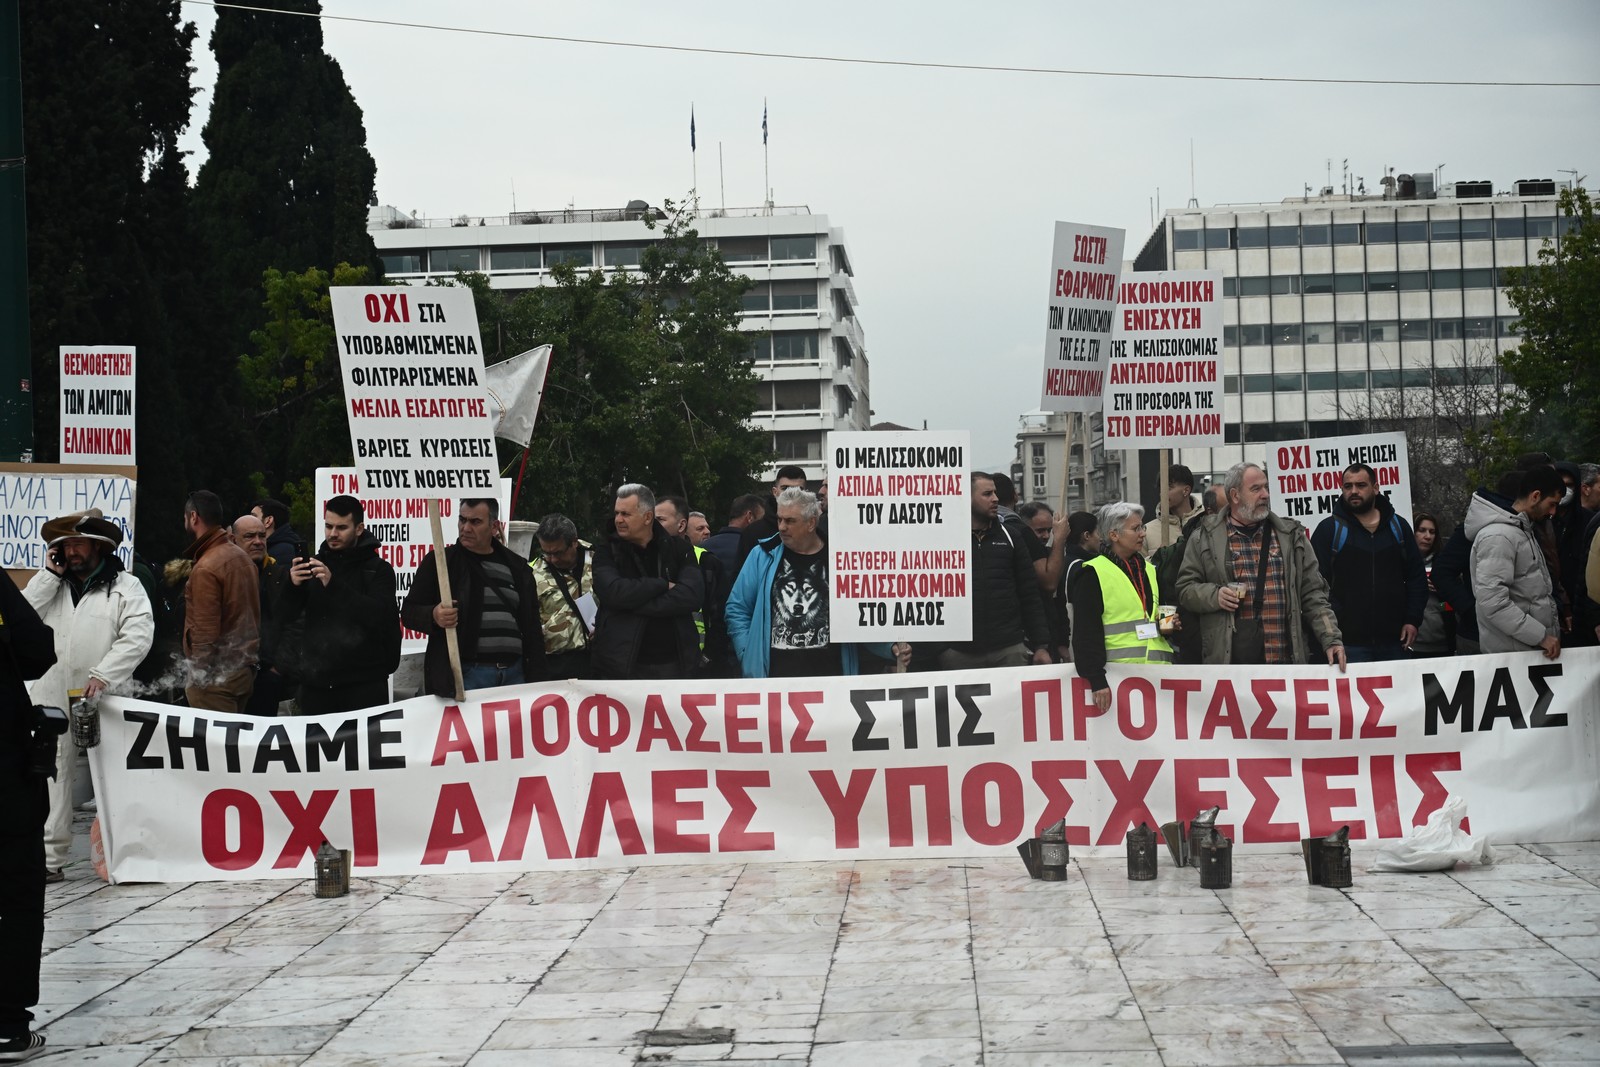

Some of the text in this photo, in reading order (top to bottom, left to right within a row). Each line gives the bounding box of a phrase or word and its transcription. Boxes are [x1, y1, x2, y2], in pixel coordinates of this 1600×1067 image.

[1073, 234, 1107, 264] ΣΩΣΤΗ
[1056, 269, 1116, 301] ΕΦΑΡΜΟΓΗ
[364, 294, 446, 323] ΟΧΙ ΣΤΑ
[1124, 308, 1201, 330] ΕΝΙΣΧΥΣΗ
[1050, 306, 1112, 334] ΤΩΝ ΚΑΝΟΝΙΣΜΩΝ
[342, 335, 478, 354] ΥΠΟΒΑΘΜΙΣΜΕΝΑ
[1060, 337, 1073, 360] ΤΗΣ
[1088, 339, 1100, 362] ΣΤΗ
[1134, 338, 1218, 357] ΜΕΛΙΣΣΟΚΟΜΙΑΣ
[64, 354, 131, 376] ΘΕΣΜΟΘΕΤΗΣΗ
[1110, 361, 1216, 384] ΑΝΤΑΠΟΔΟΤΙΚΗ
[352, 367, 478, 386] ΦΙΛΤΡΑΡΙΣΜΕΝΑ
[1046, 368, 1104, 396] ΜΕΛΙΣΣΟΚΟΜΙΑ
[64, 389, 132, 416] ΤΩΝ ΑΜΙΓΩΝ
[352, 398, 487, 418] ΜΕΛΙΑ ΕΙΣΑΓΩΓΗΣ
[1114, 391, 1214, 410] ΣΤΗ ΠΡΟΣΦΟΡΑ ΤΗΣ
[1107, 414, 1220, 437] ΣΤΟ ΠΕΡΙΒΑΛΛΟΝ
[64, 427, 132, 455] ΕΛΛΗΝΙΚΩΝ
[357, 438, 493, 458] ΒΑΡΙΕΣ ΚΥΡΩΣΕΙΣ
[836, 446, 962, 468] ΟΙ ΜΕΛΙΣΣΟΚΟΜΟΙ
[1278, 444, 1396, 470] ΟΧΙ ΣΤΗ ΜΕΙΩΣΗ
[332, 474, 344, 494] ΤΟ
[366, 470, 410, 488] ΣΤΟΥΣ
[414, 470, 492, 488] ΝΟΘΕΥΤΕΣ
[838, 474, 962, 496] ΑΣΠΙΔΑ ΠΡΟΣΤΑΣΙΑΣ
[1278, 474, 1308, 494] ΤΩΝ
[406, 498, 451, 518] ΜΗΤΩΟ
[857, 502, 942, 524] ΤΟΥ ΔΑΣΟΥΣ
[1285, 496, 1313, 516] ΤΗΣ
[836, 550, 966, 570] ΕΛΕΥΘΕΡΗ ΔΙΑΚΙΝΗΣΗ
[836, 573, 966, 598] ΜΕΛΙΣΣΟΚΟΜΩΝ
[858, 602, 944, 626] ΣΤΟ ΔΑΣΟΣ
[122, 664, 1568, 774] ΖΗΤΑΜΕ ΑΠΟΦΑΣΕΙΣ ΣΤΙΣ ΠΡΟΤΑΣΕΙΣ ΜΑΣ
[201, 752, 1471, 870] ΟΧΙ ΑΛΛΕΣ ΥΠΟΣΧΕΣΕΙΣ
